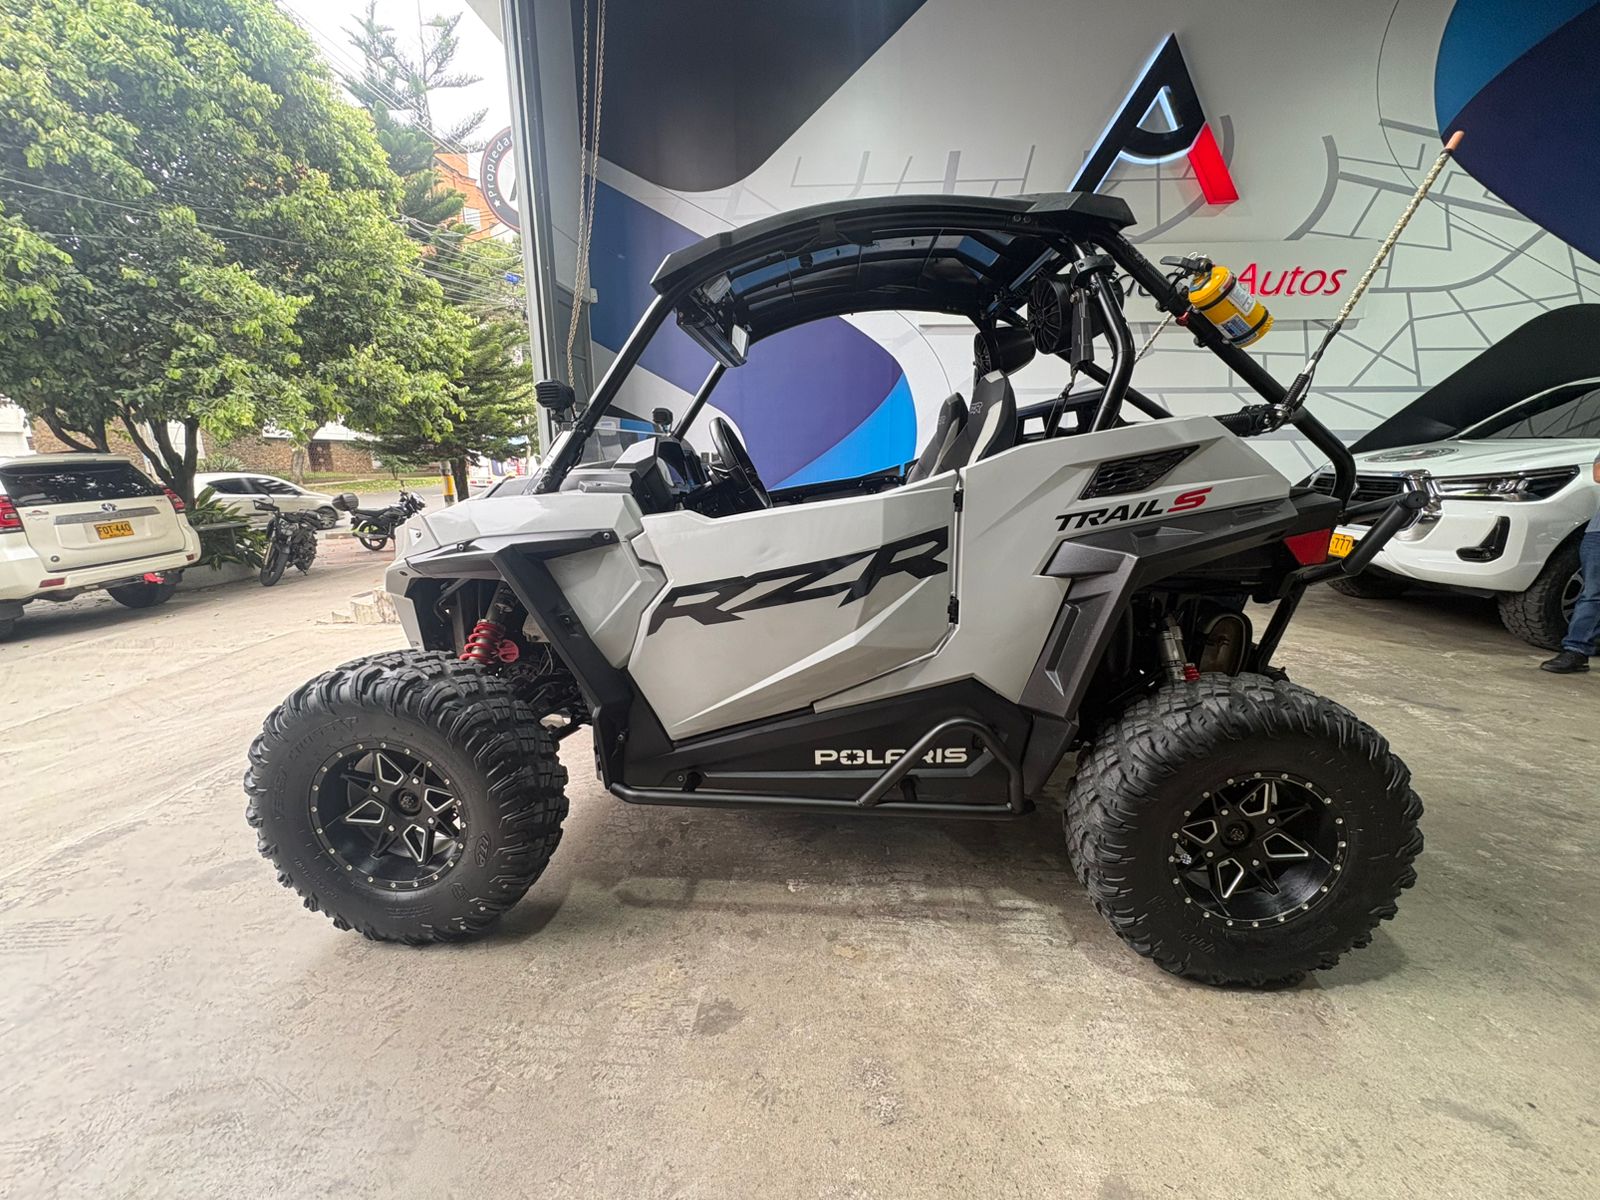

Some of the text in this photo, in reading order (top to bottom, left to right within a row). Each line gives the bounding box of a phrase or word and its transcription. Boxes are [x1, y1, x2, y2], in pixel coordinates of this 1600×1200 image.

[486, 134, 513, 198] Propieda
[1238, 263, 1347, 297] Autos
[1056, 486, 1213, 532] TRAIL S
[647, 525, 948, 637] RZR
